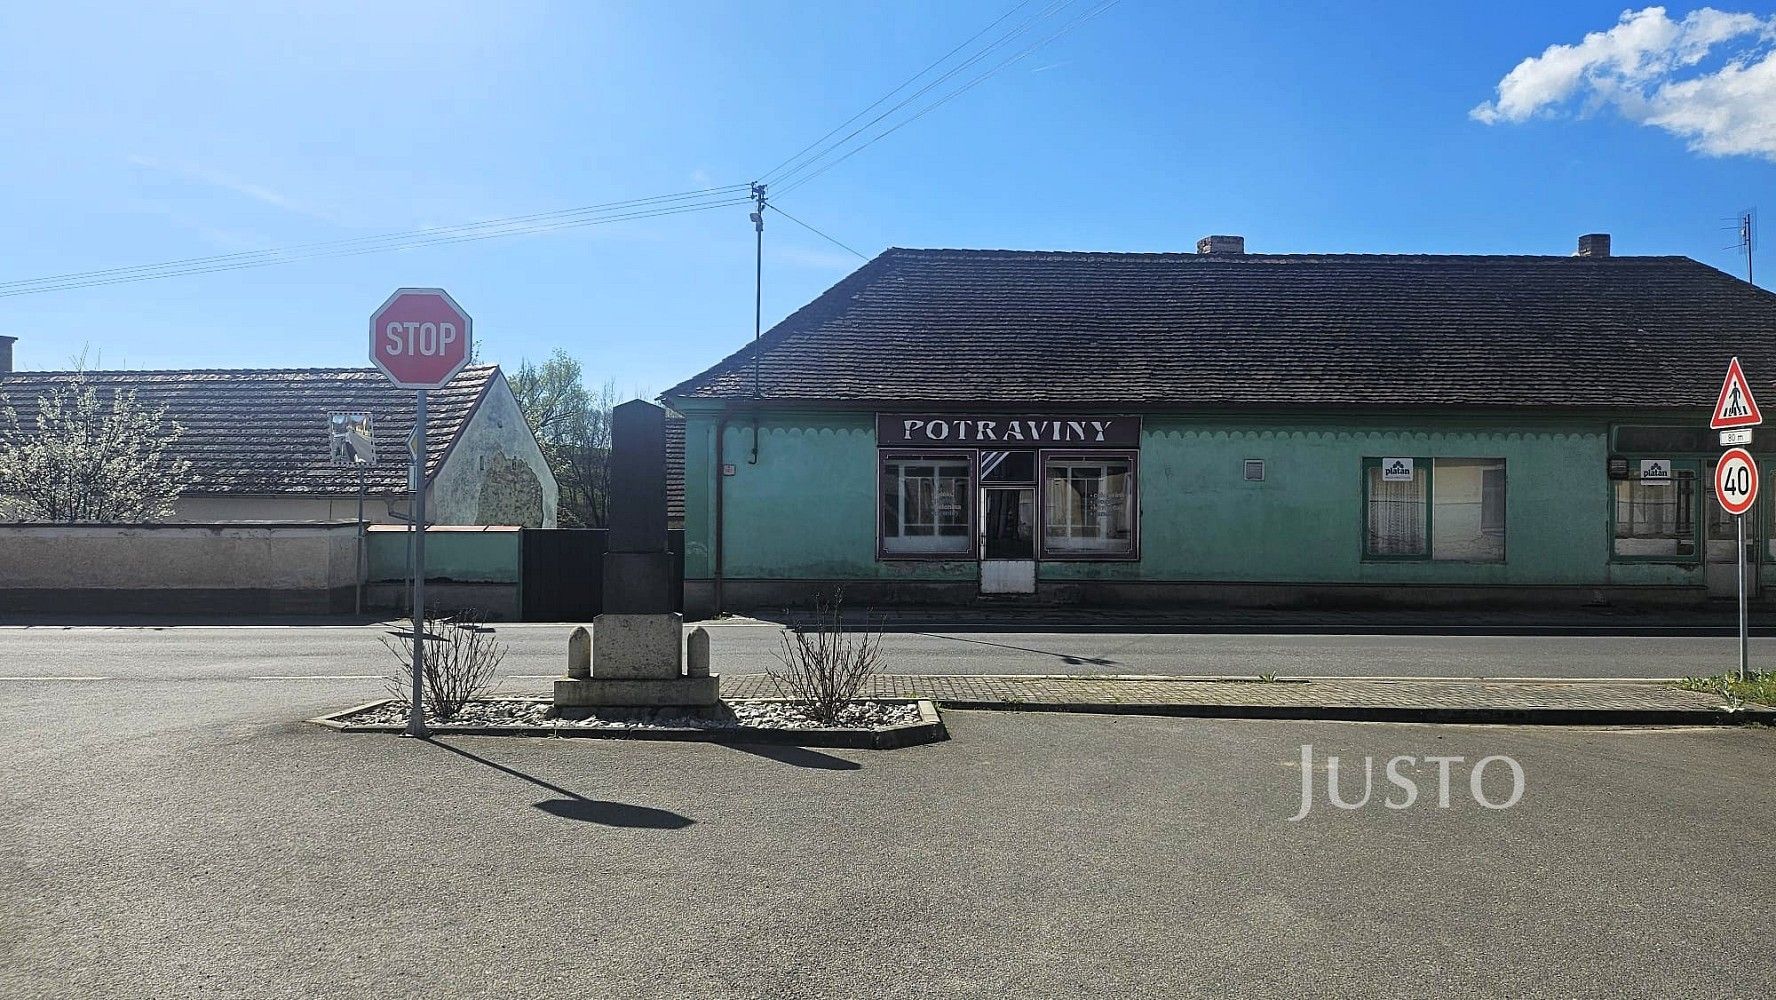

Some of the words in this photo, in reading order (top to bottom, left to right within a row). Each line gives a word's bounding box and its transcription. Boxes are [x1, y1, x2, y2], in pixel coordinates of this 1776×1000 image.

[385, 321, 456, 356] STOP
[903, 419, 1112, 442] POTRAVINY
[1727, 433, 1736, 442] 80
[1385, 467, 1410, 476] platan
[1643, 469, 1668, 478] platan
[1724, 466, 1749, 496] 40
